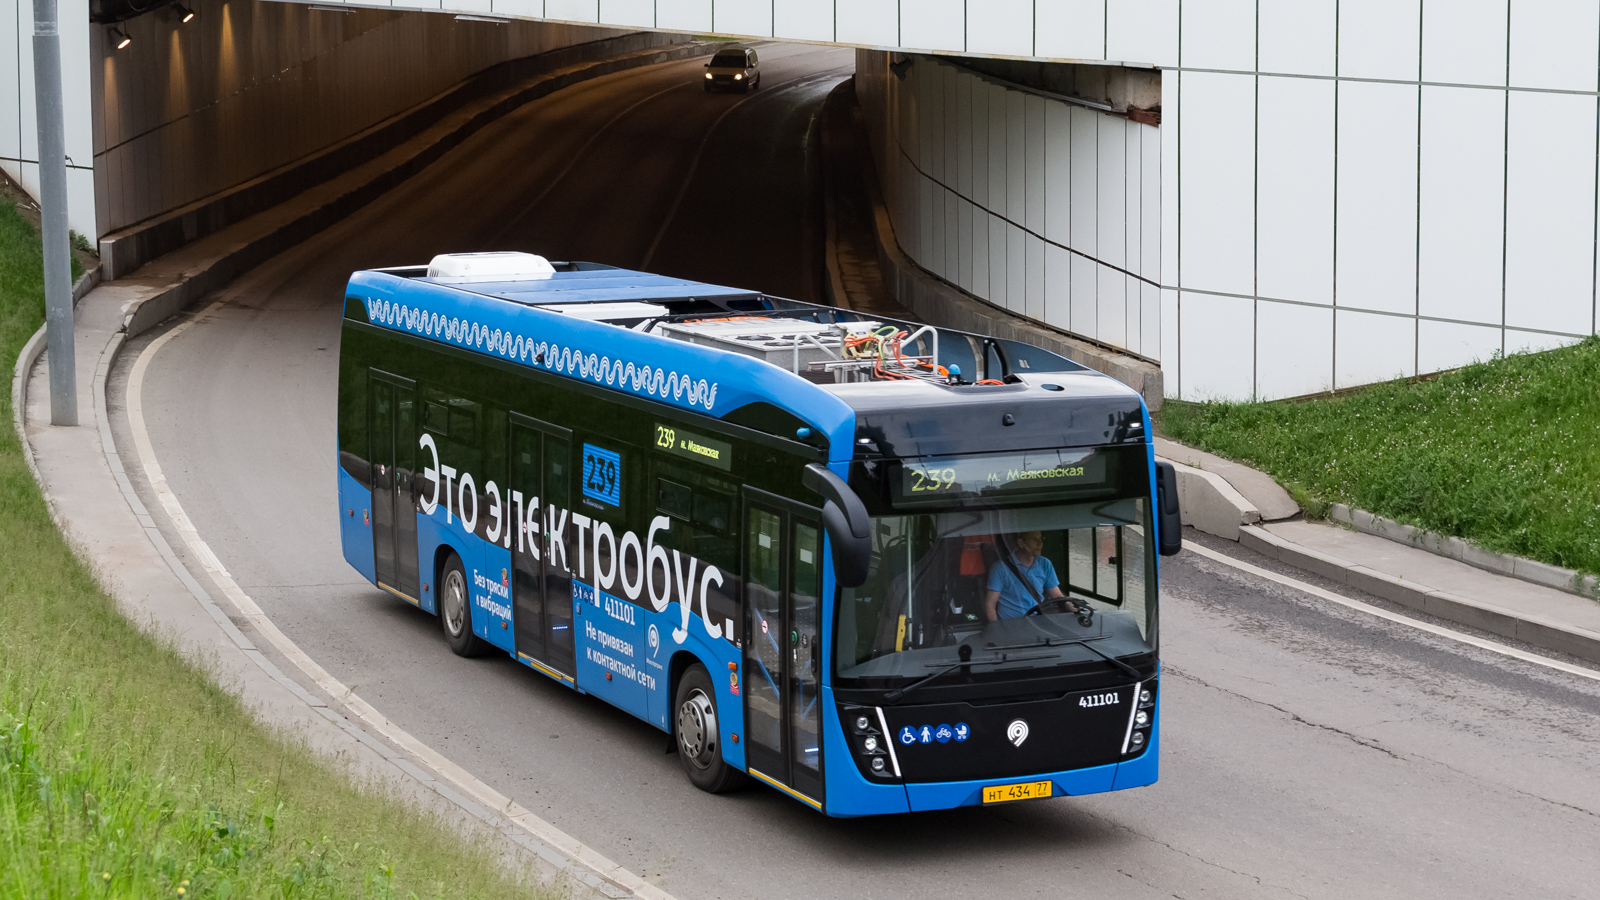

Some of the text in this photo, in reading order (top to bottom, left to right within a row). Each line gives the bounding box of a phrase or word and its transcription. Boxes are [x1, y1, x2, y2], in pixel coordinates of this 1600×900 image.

[657, 425, 675, 449] 239
[586, 454, 616, 496] 239
[911, 466, 1084, 492] 239 м. Маяковская
[419, 433, 734, 645] Это электробус.
[473, 568, 509, 599] Без тряски
[480, 595, 511, 622] вибраций
[604, 596, 636, 626] 411101
[585, 620, 634, 658] Не привязан
[586, 647, 592, 660] к
[593, 650, 636, 681] контактной
[637, 671, 656, 691] сети
[1079, 692, 1120, 708] 411101
[1008, 785, 1030, 798] 434
[1037, 783, 1048, 792] 77
